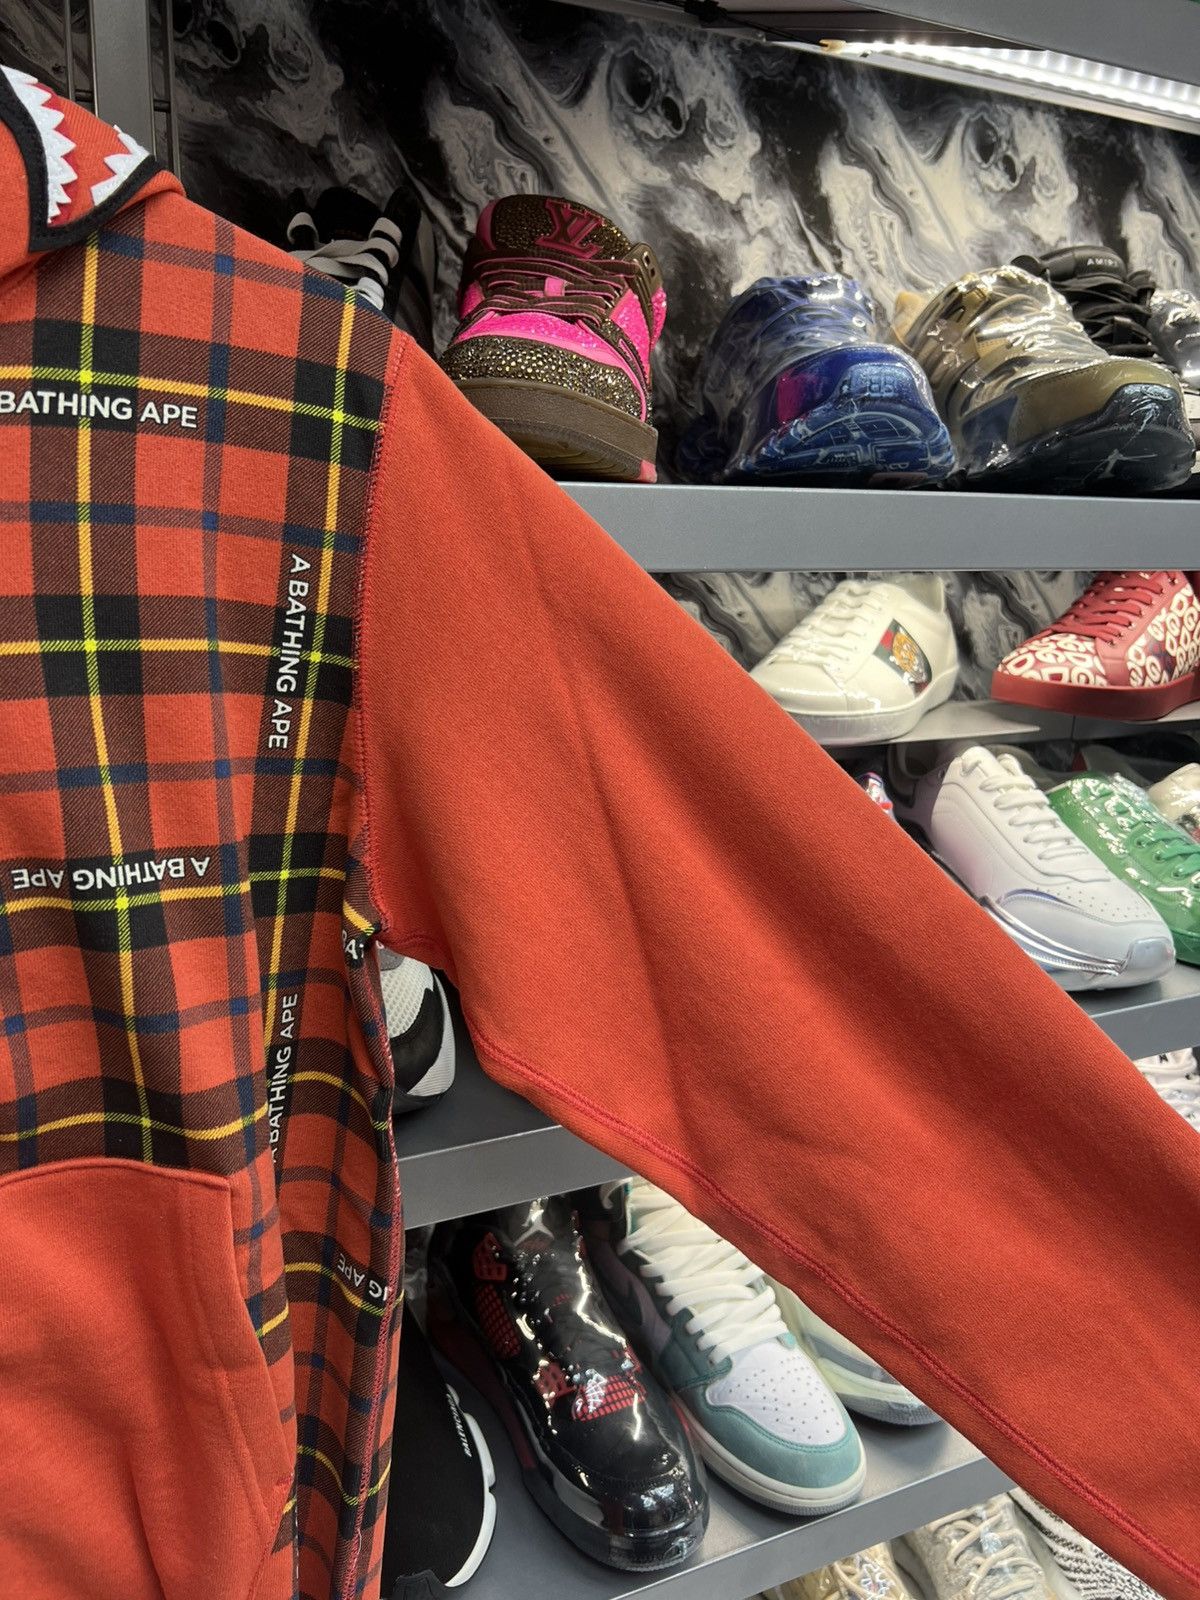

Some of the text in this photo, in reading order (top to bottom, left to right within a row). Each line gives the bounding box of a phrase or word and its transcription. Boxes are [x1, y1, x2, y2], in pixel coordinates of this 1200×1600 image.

[0, 390, 198, 429] BATHING APE
[268, 553, 311, 749] A BATHING APE
[11, 856, 211, 891] A BATHING APE
[280, 993, 298, 1039] APE
[337, 1253, 366, 1288] APE
